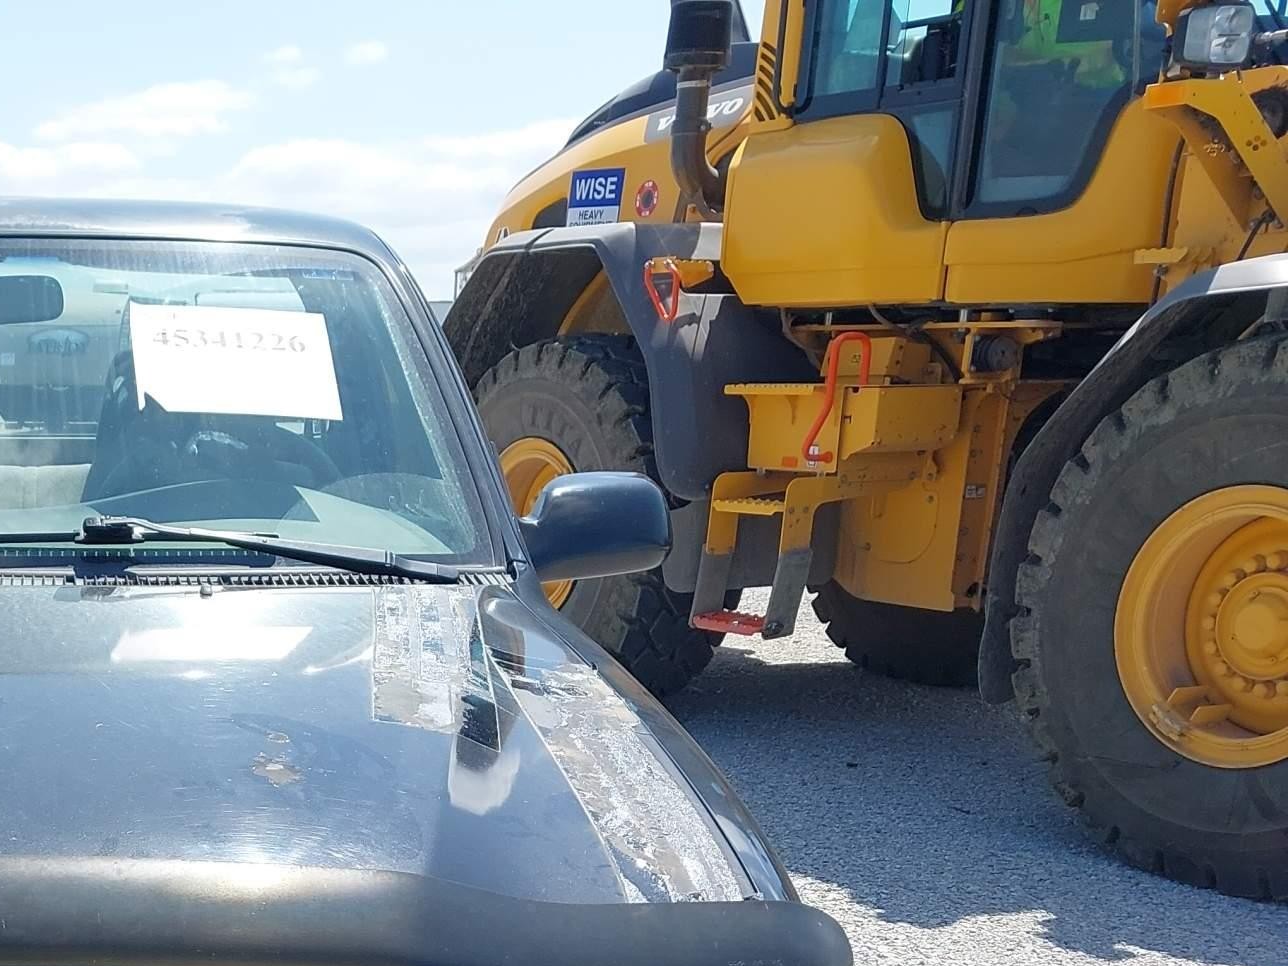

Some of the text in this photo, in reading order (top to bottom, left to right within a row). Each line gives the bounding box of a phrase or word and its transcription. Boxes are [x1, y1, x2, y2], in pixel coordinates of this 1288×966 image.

[657, 97, 744, 131] VVO
[575, 176, 618, 201] WISE
[578, 209, 605, 221] HEAVY
[152, 327, 307, 353] 45341226
